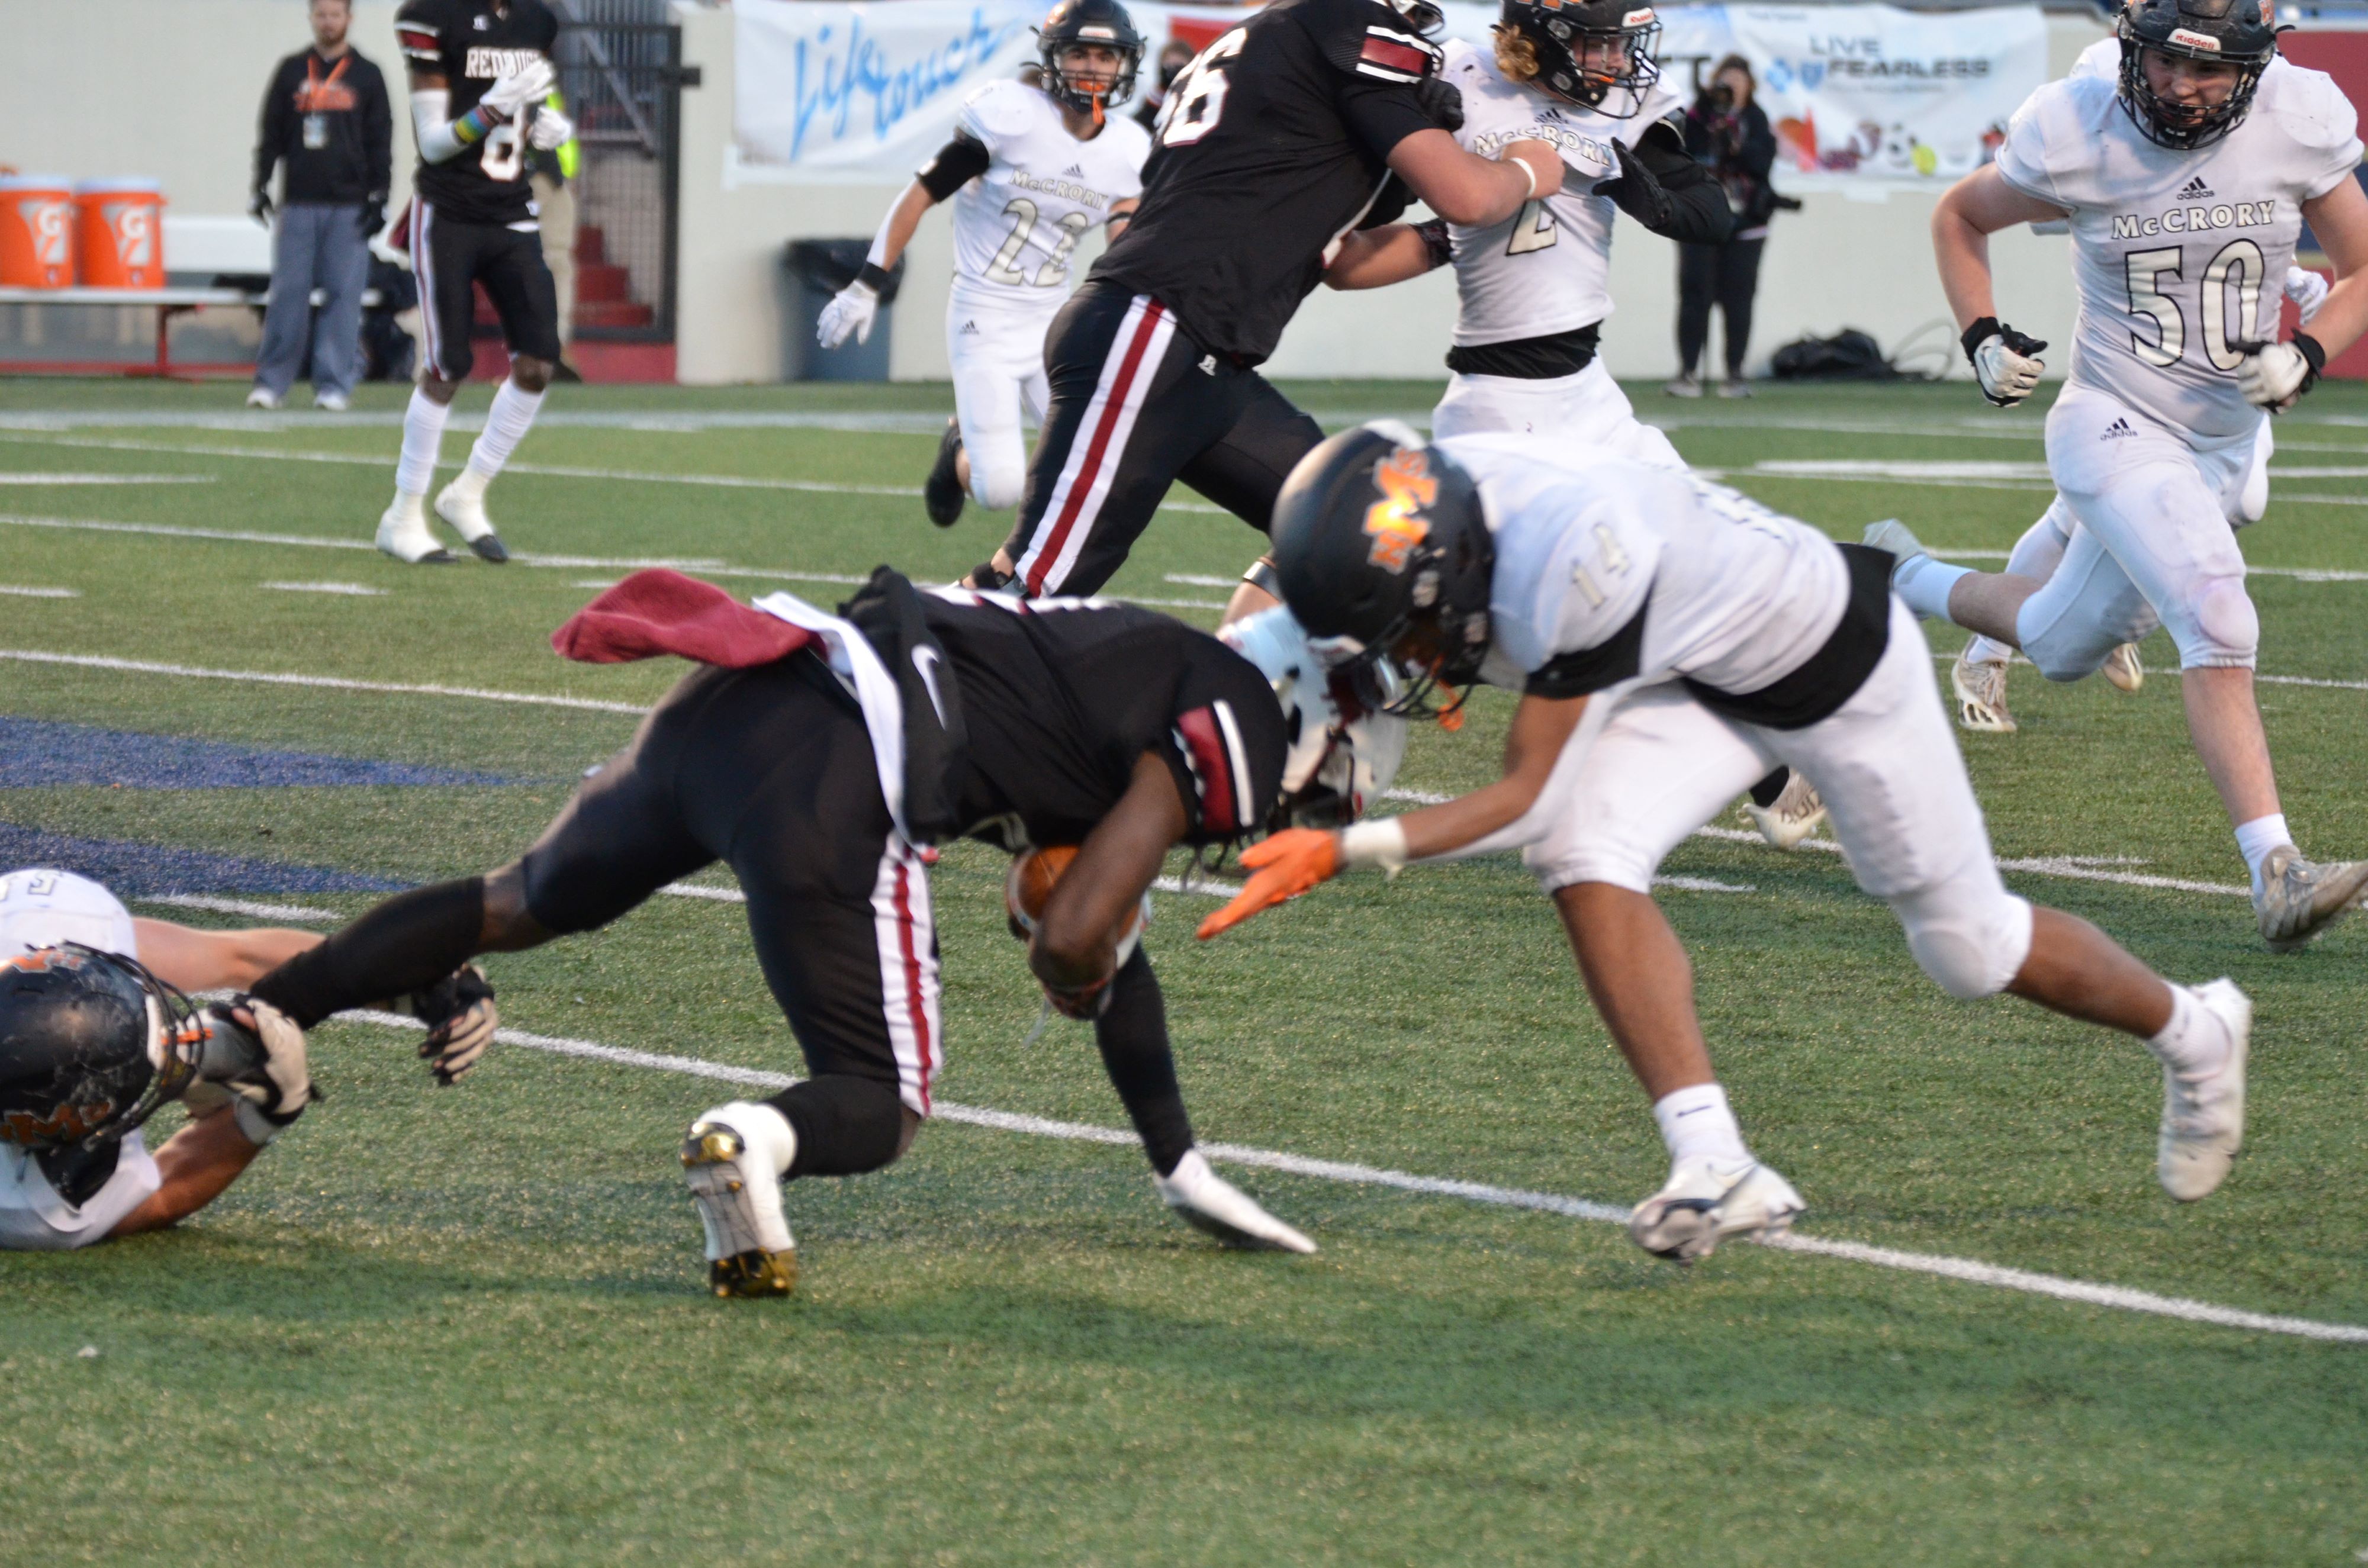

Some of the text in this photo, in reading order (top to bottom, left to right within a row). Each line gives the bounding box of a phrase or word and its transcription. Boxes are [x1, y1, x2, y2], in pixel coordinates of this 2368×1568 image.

[1809, 34, 1881, 56] LIVE
[2175, 33, 2215, 50] Riddell
[1826, 59, 1990, 78] FEARLESS
[1008, 169, 1109, 210] McCRORY
[2177, 189, 2215, 200] adidas
[2111, 200, 2274, 239] McCRORY
[2125, 238, 2265, 371] 50
